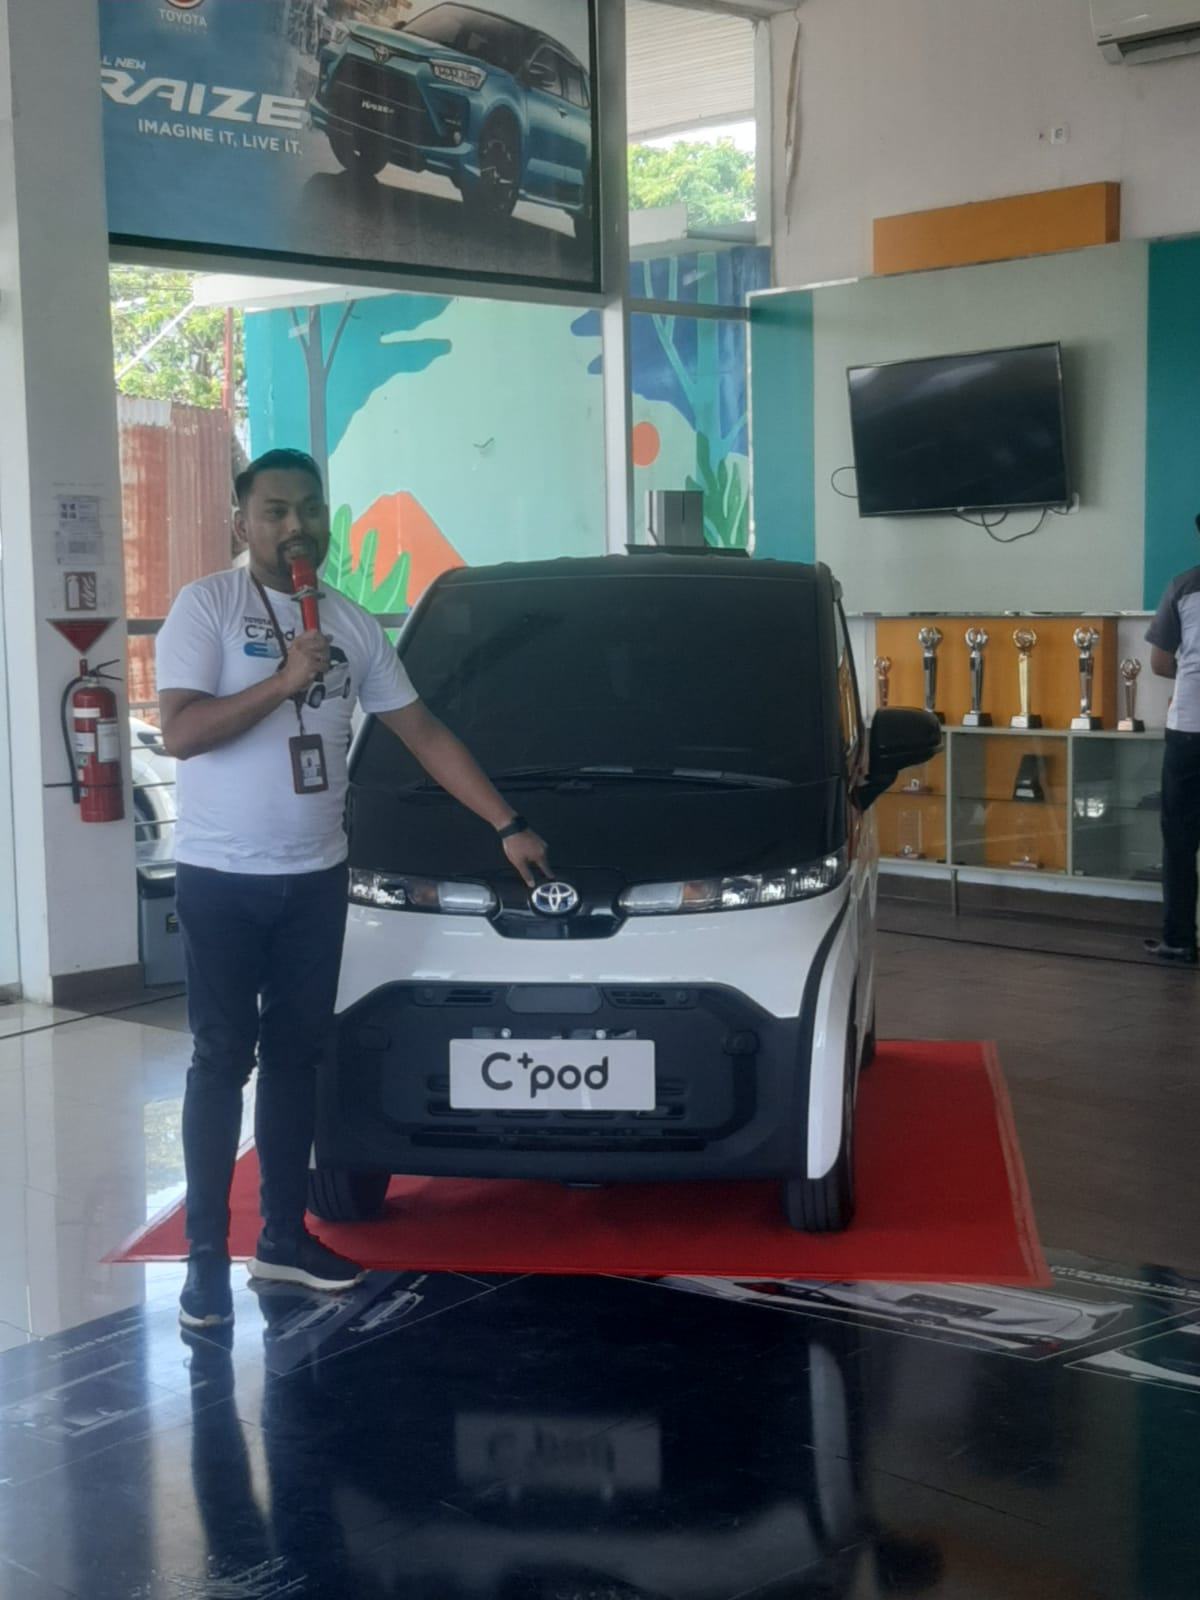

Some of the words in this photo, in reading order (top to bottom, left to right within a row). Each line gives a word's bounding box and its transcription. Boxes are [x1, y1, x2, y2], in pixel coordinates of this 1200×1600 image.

[158, 8, 208, 28] TOYOTA
[115, 57, 147, 70] NEW
[101, 69, 306, 129] RAIZE
[138, 119, 214, 143] IMAGINE
[219, 130, 238, 148] IT,
[243, 134, 280, 152] LIVE
[285, 140, 304, 154] IT.
